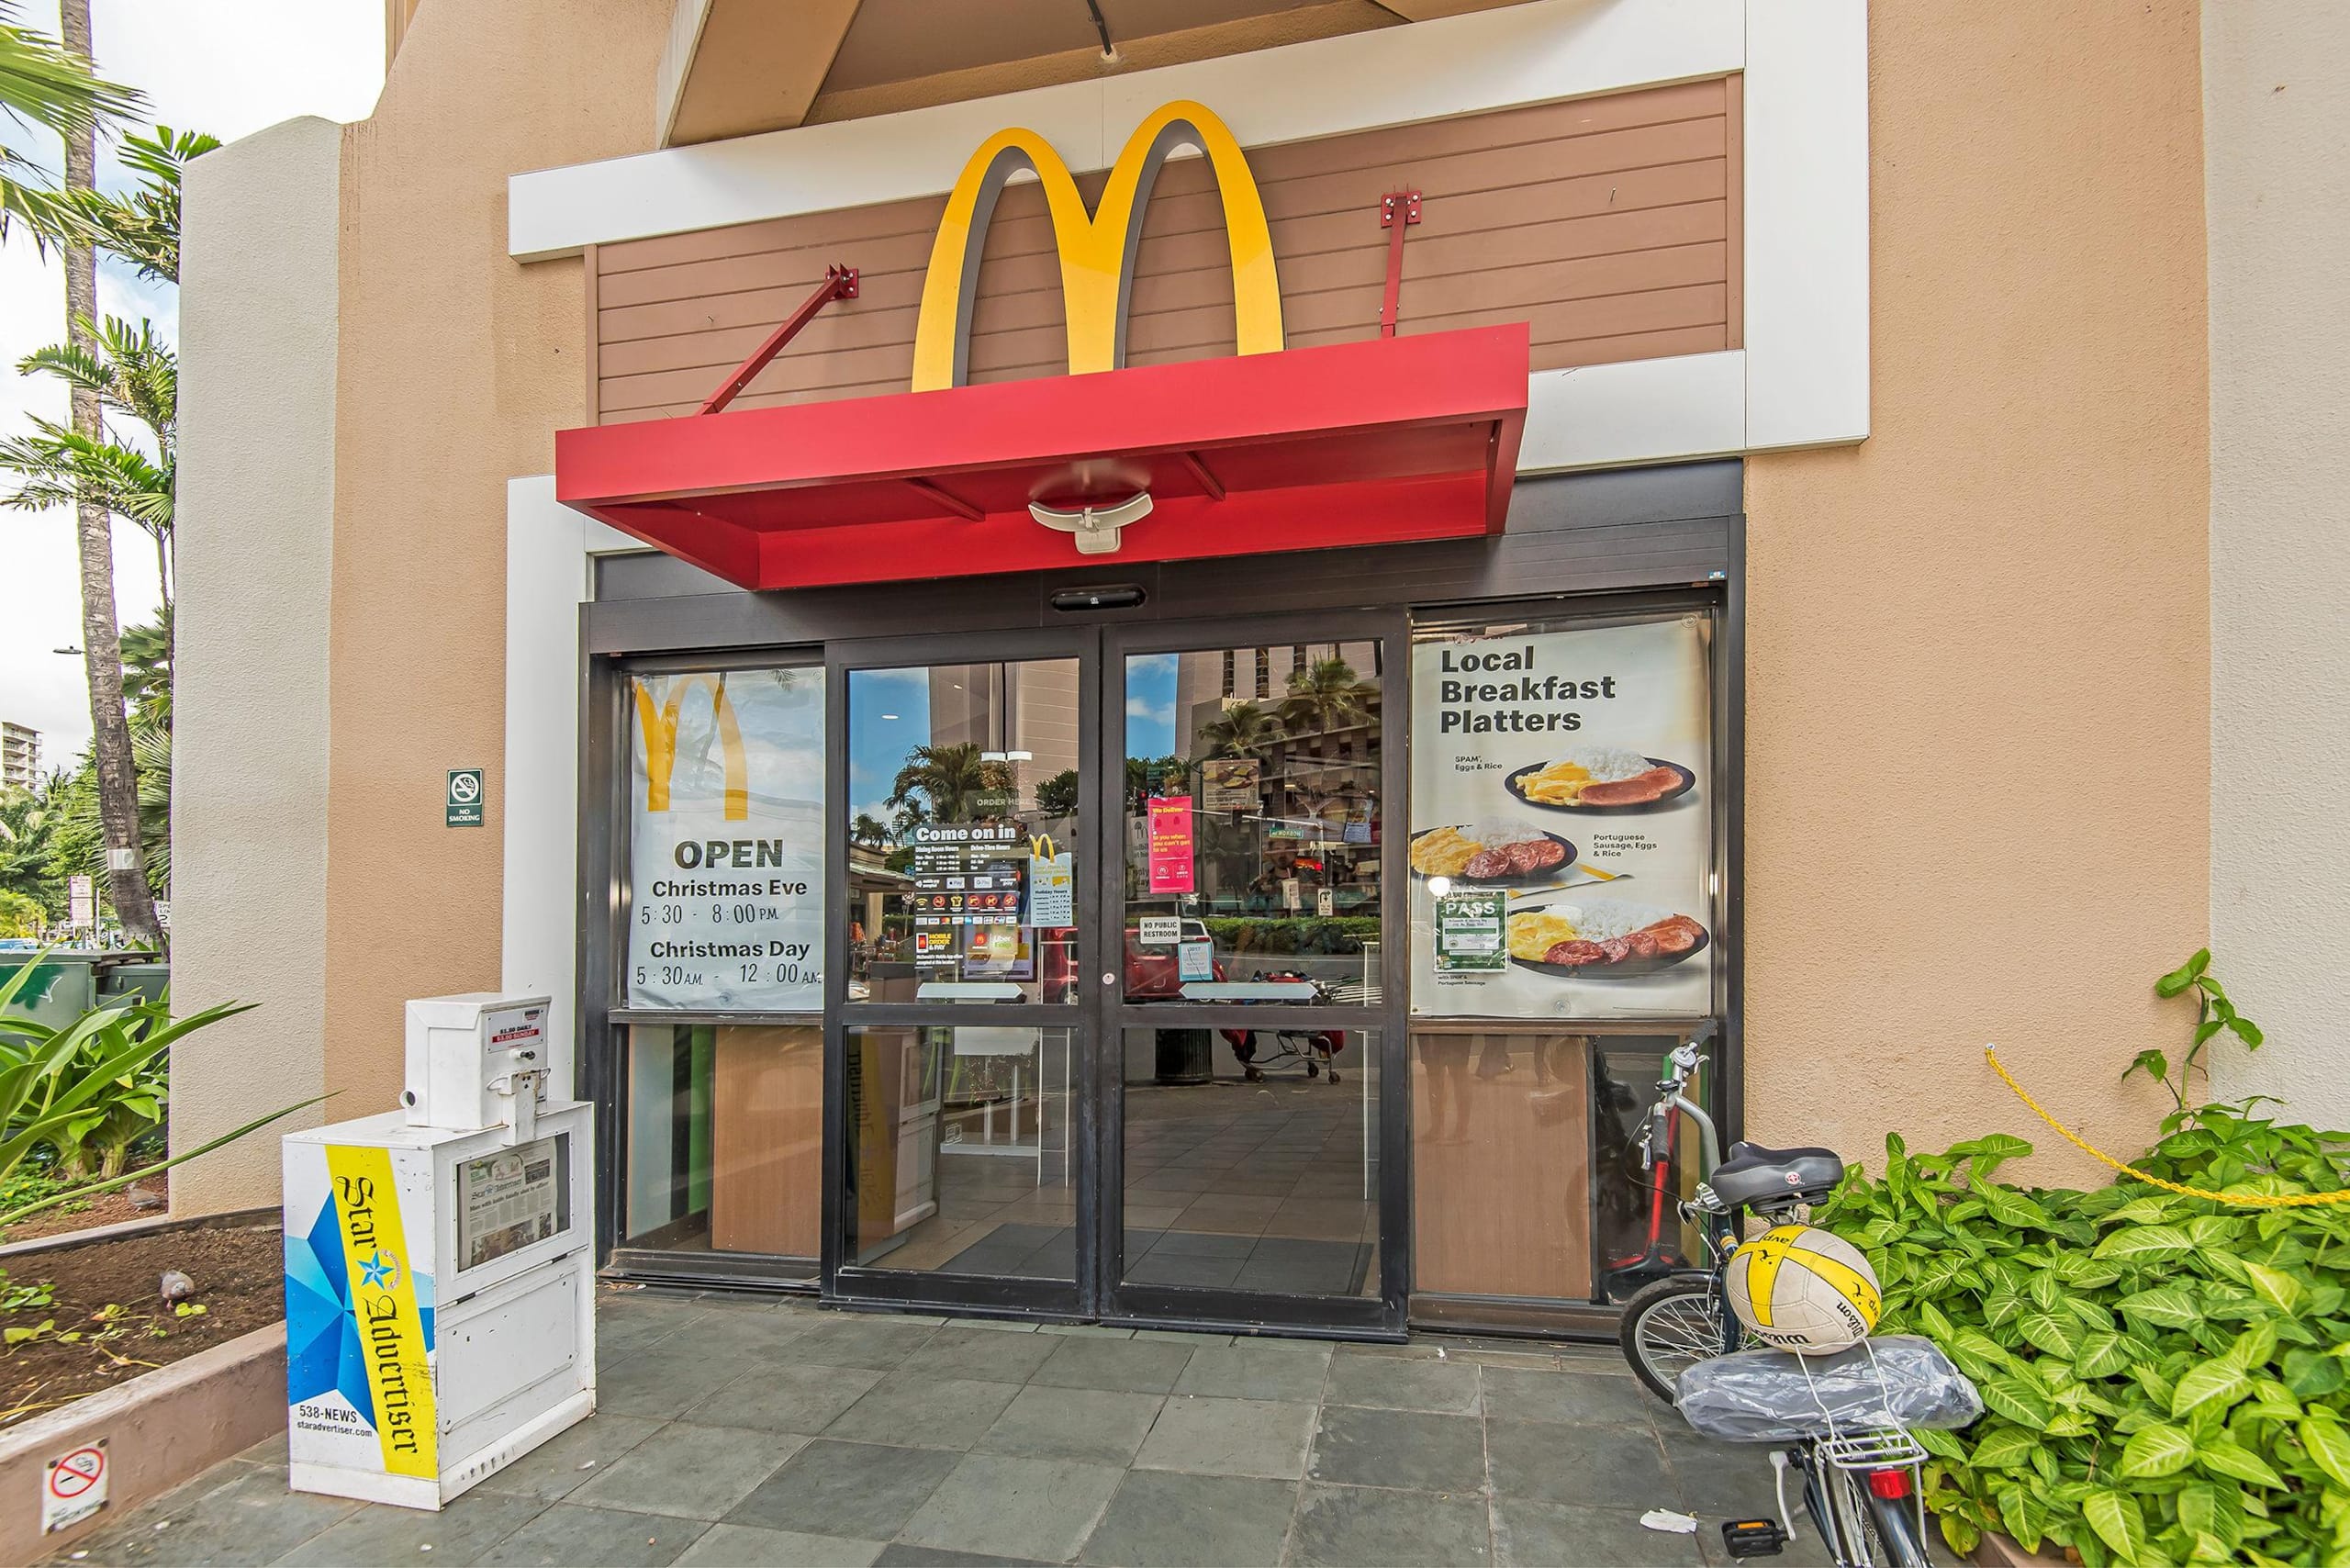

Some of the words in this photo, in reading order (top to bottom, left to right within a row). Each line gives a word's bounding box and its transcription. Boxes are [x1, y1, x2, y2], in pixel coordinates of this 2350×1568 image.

[1441, 645, 1534, 673] Local
[1441, 676, 1616, 703] Breakfast
[1440, 710, 1582, 734] Platters
[1455, 763, 1475, 772] Eggs
[916, 827, 968, 842] Come
[971, 828, 995, 840] on
[998, 823, 1016, 839] in
[1593, 834, 1646, 842] Portuguese
[674, 839, 783, 869] OPEN
[1593, 842, 1634, 850] Sausage,
[1635, 842, 1658, 850] Eggs
[652, 879, 763, 898] Christmas
[769, 879, 808, 895] Eve
[711, 903, 755, 924] 8:00
[1445, 902, 1495, 915] PASS
[1143, 930, 1178, 938] RESTROOM
[650, 940, 764, 958] Christmas
[769, 940, 811, 961] Day
[335, 1175, 377, 1249] Star
[1763, 1234, 1790, 1244] avp
[1836, 1299, 1864, 1338] Wilson
[363, 1294, 419, 1454] Advertiser
[299, 1405, 357, 1423] 538-NEWS
[297, 1420, 373, 1438] staradvertiser.com
